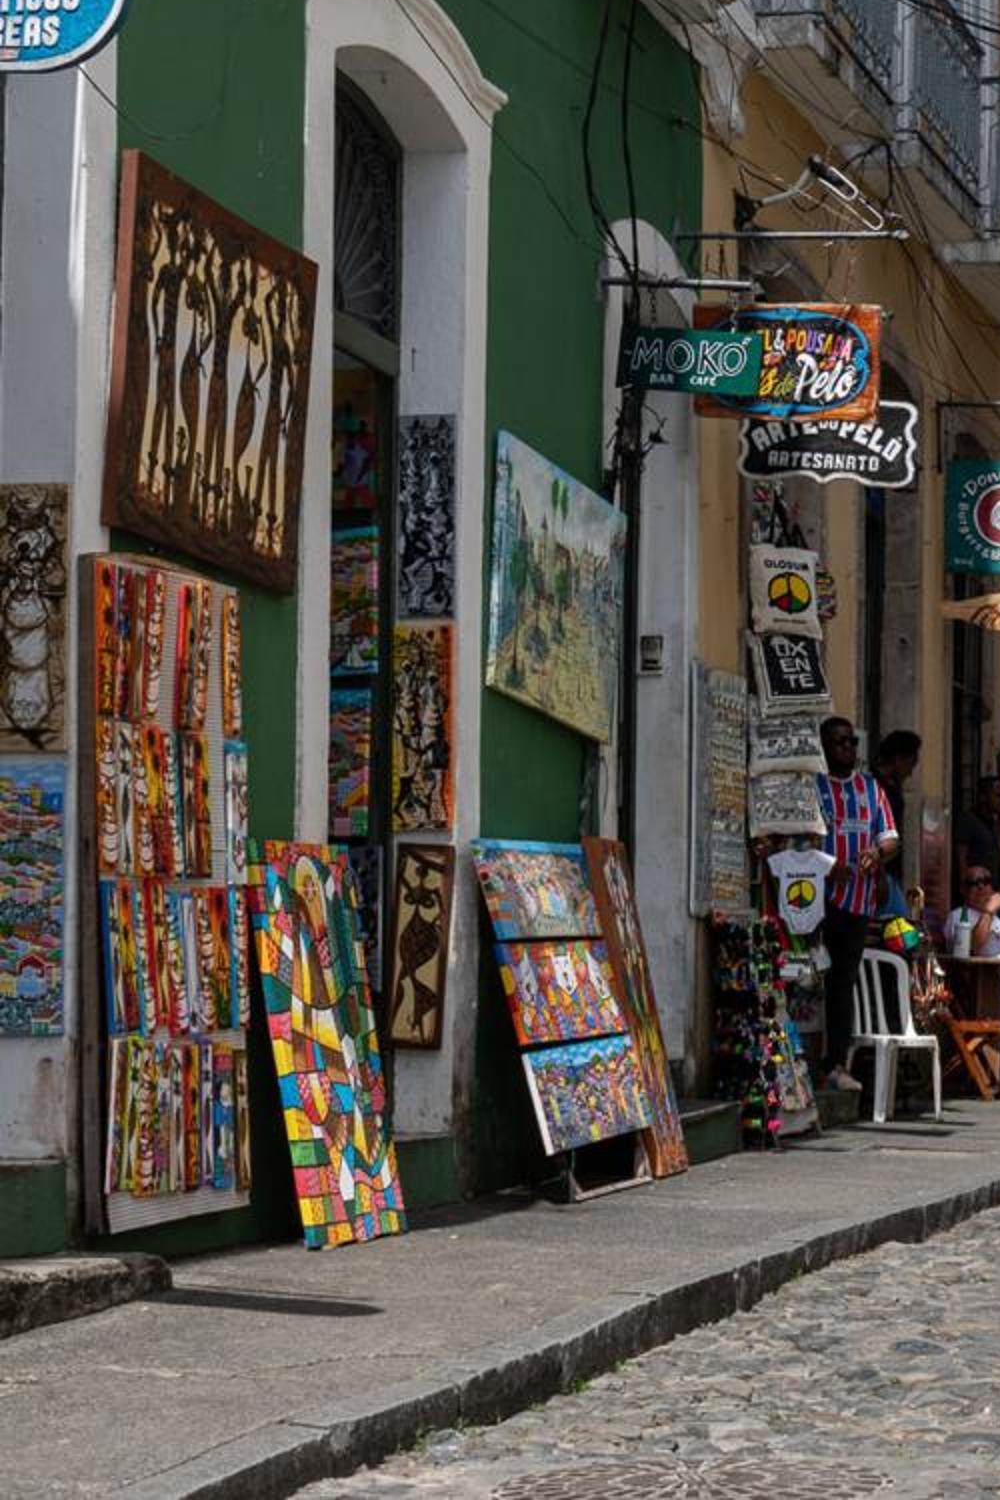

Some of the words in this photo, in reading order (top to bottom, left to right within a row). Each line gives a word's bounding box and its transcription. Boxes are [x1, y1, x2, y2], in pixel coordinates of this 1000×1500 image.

[785, 327, 853, 362] POUSADA
[794, 353, 858, 402] Pelô
[768, 450, 879, 471] ARTESANATO
[780, 657, 811, 673] EN
[783, 673, 815, 688] TE
